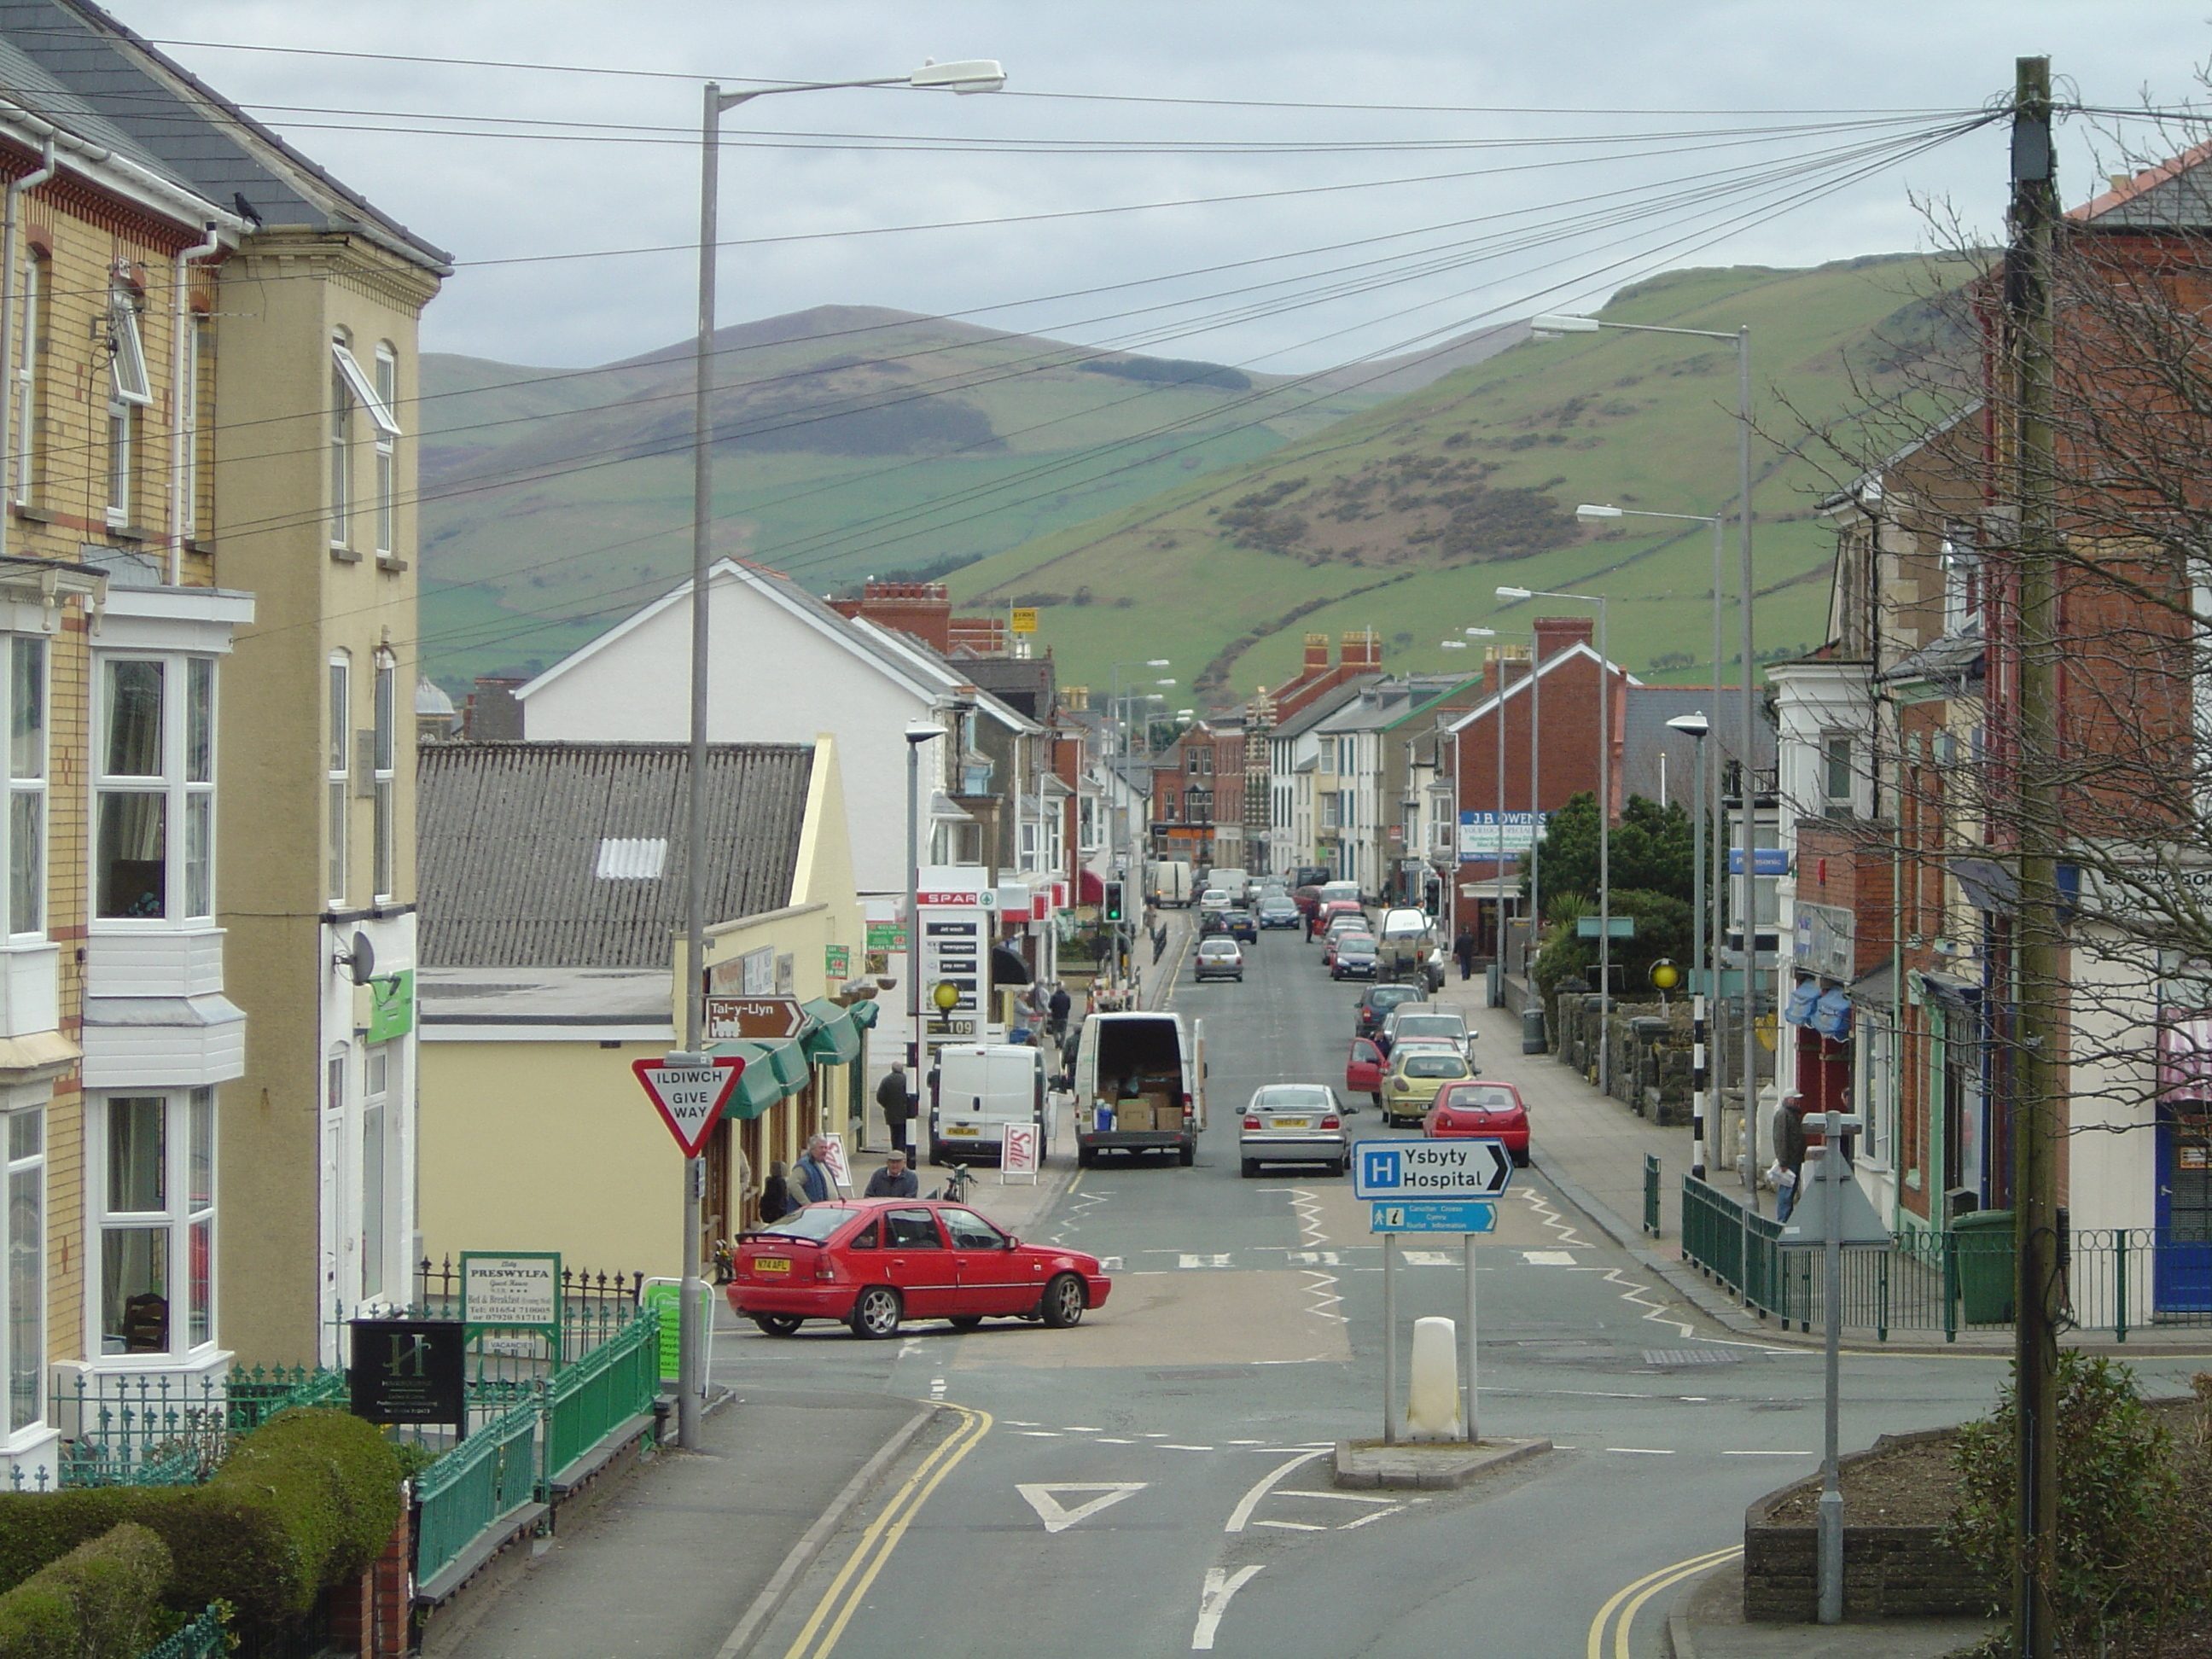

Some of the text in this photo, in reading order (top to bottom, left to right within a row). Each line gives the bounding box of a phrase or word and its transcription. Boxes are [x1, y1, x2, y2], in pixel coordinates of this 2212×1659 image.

[928, 894, 976, 903] SPAR
[711, 1003, 773, 1016] Tal-y-Llyn
[948, 1022, 972, 1034] 109
[657, 1071, 722, 1083] ILDIWCH
[672, 1091, 708, 1103] GIVE
[674, 1107, 707, 1118] WAY
[1010, 1128, 1032, 1168] Sale
[1372, 1149, 1467, 1182] H Ysbyty
[1404, 1172, 1482, 1190] Hospital
[471, 1269, 549, 1278] PRESWYLFA
[468, 1295, 480, 1304] Bed
[489, 1295, 520, 1304] Breakfast
